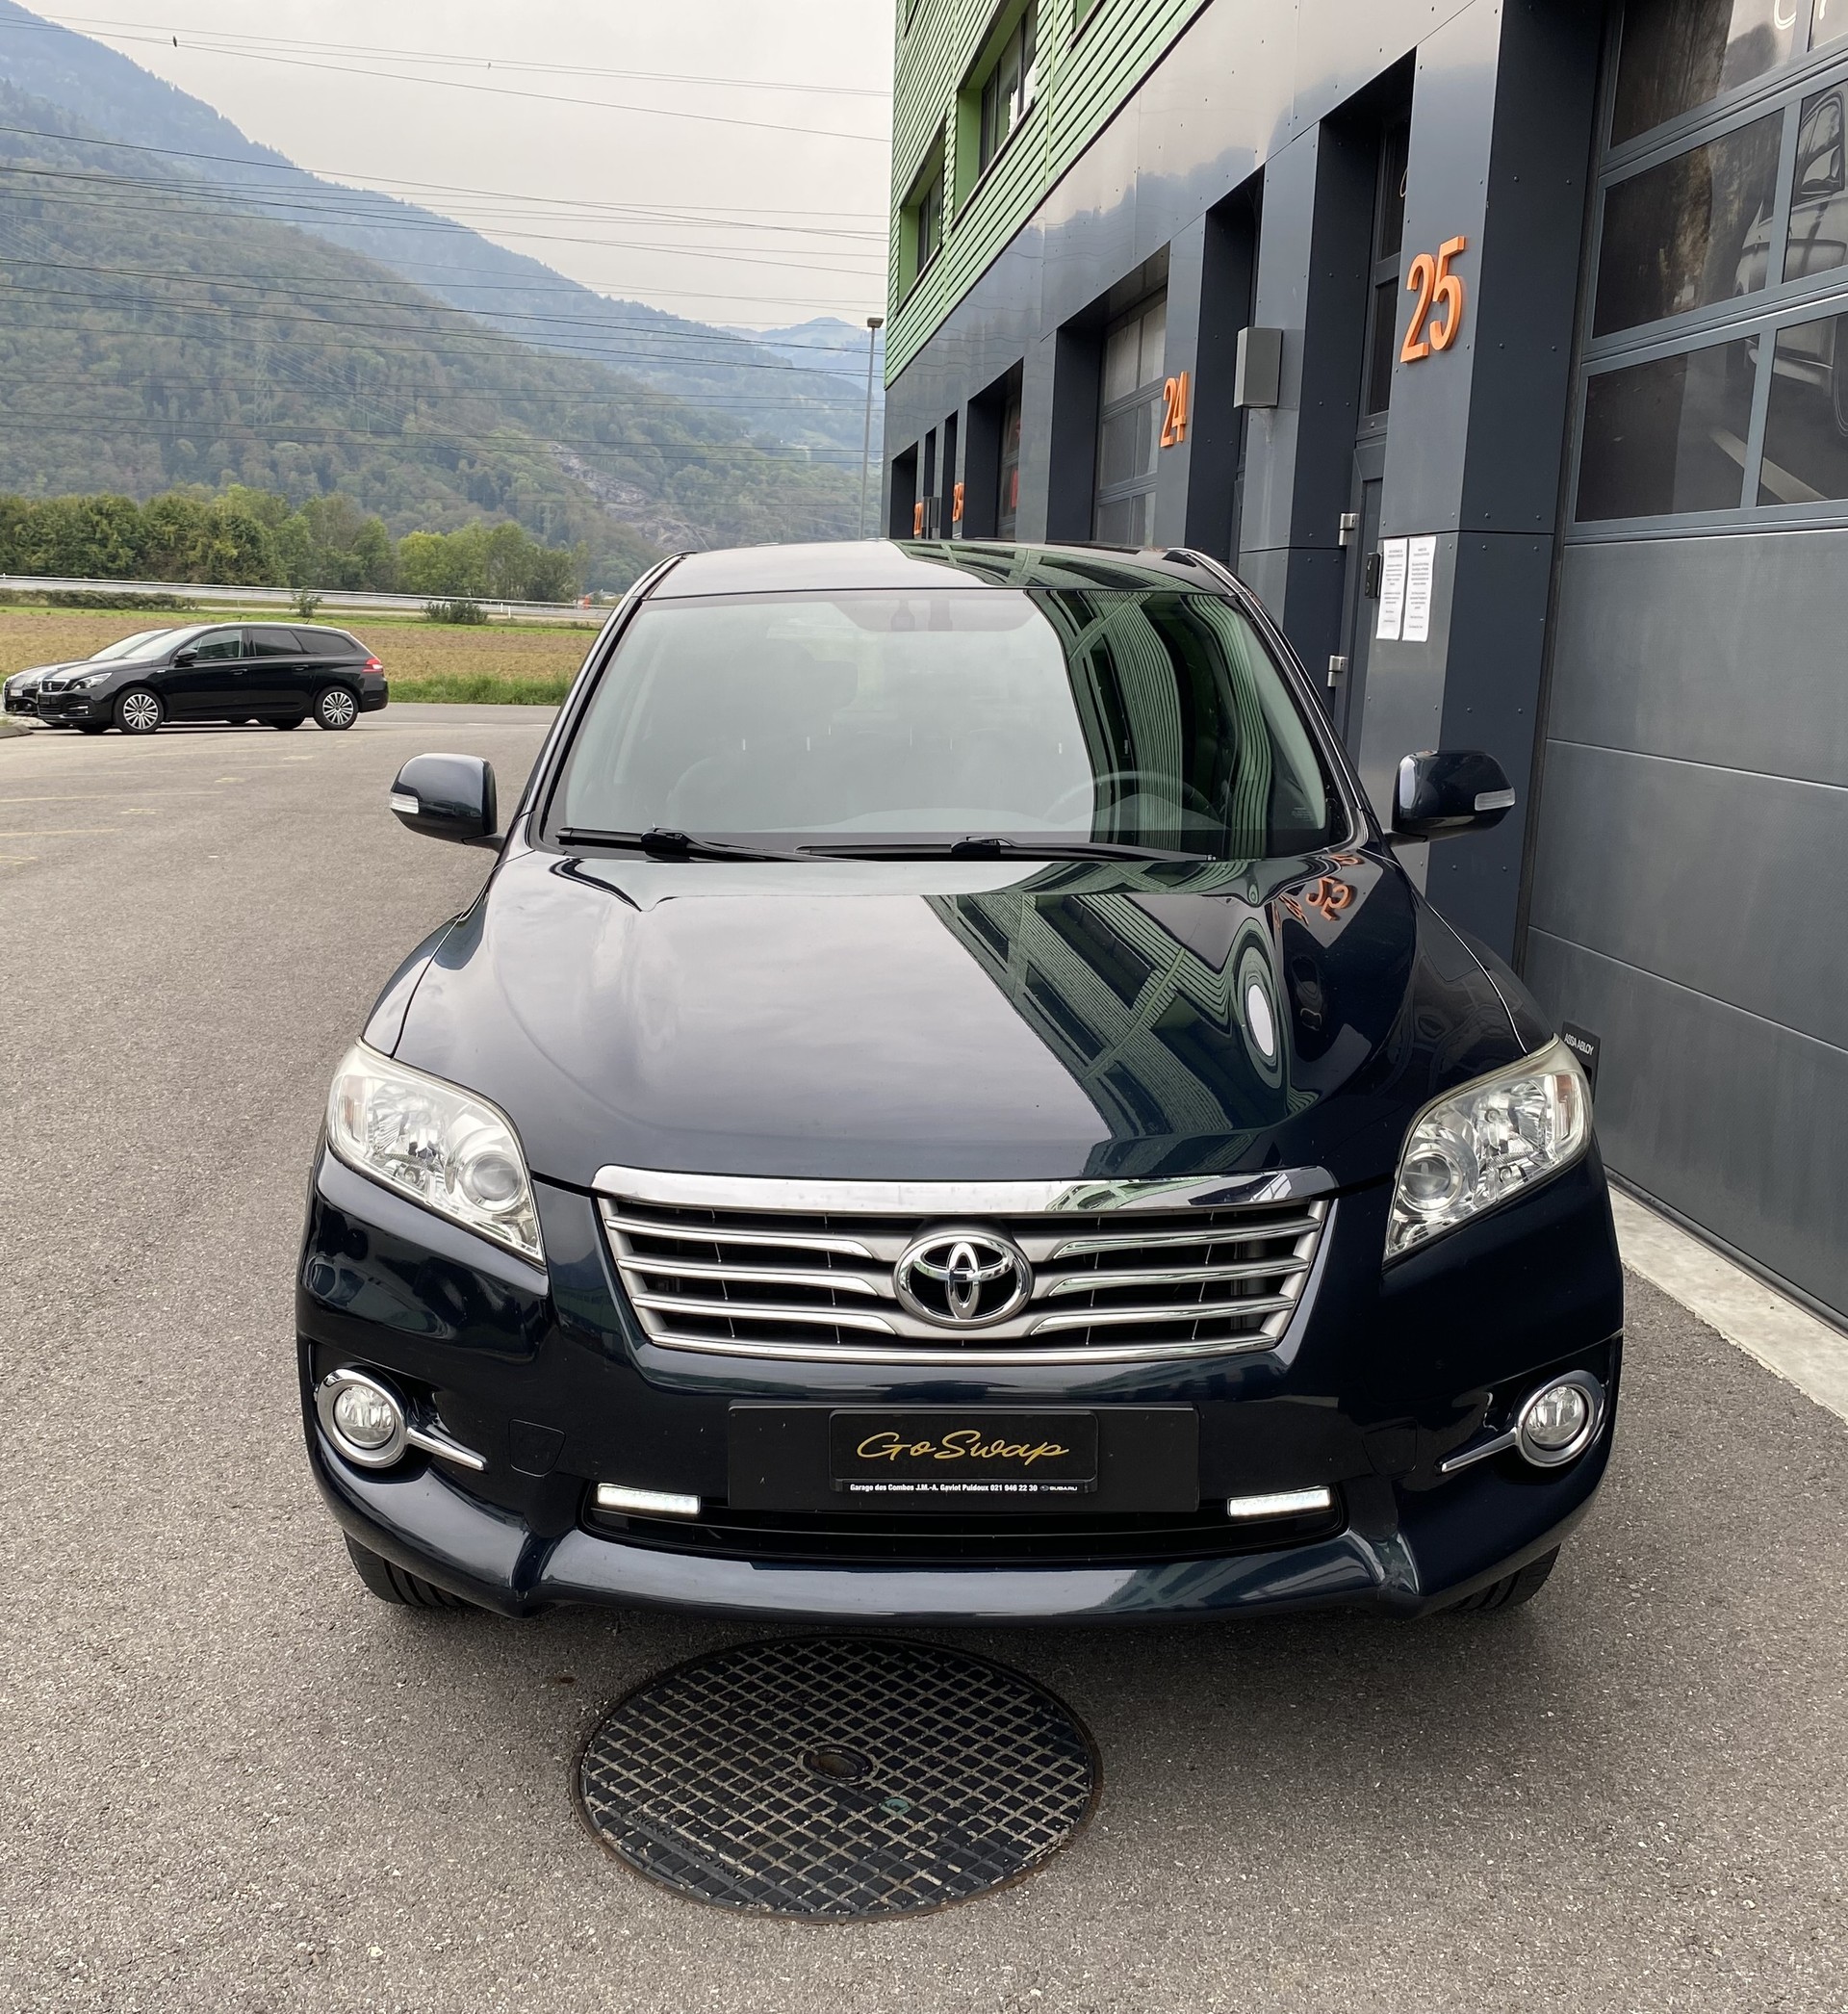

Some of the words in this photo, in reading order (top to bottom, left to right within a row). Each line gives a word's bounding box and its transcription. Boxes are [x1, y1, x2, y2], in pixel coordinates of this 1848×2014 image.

[1400, 236, 1465, 363] 25
[1160, 371, 1188, 448] 24
[1563, 1033, 1578, 1048] ASSA
[1577, 1039, 1595, 1056] ABLOY
[856, 1429, 1070, 1466] GoSwap
[850, 1484, 874, 1492] Garage
